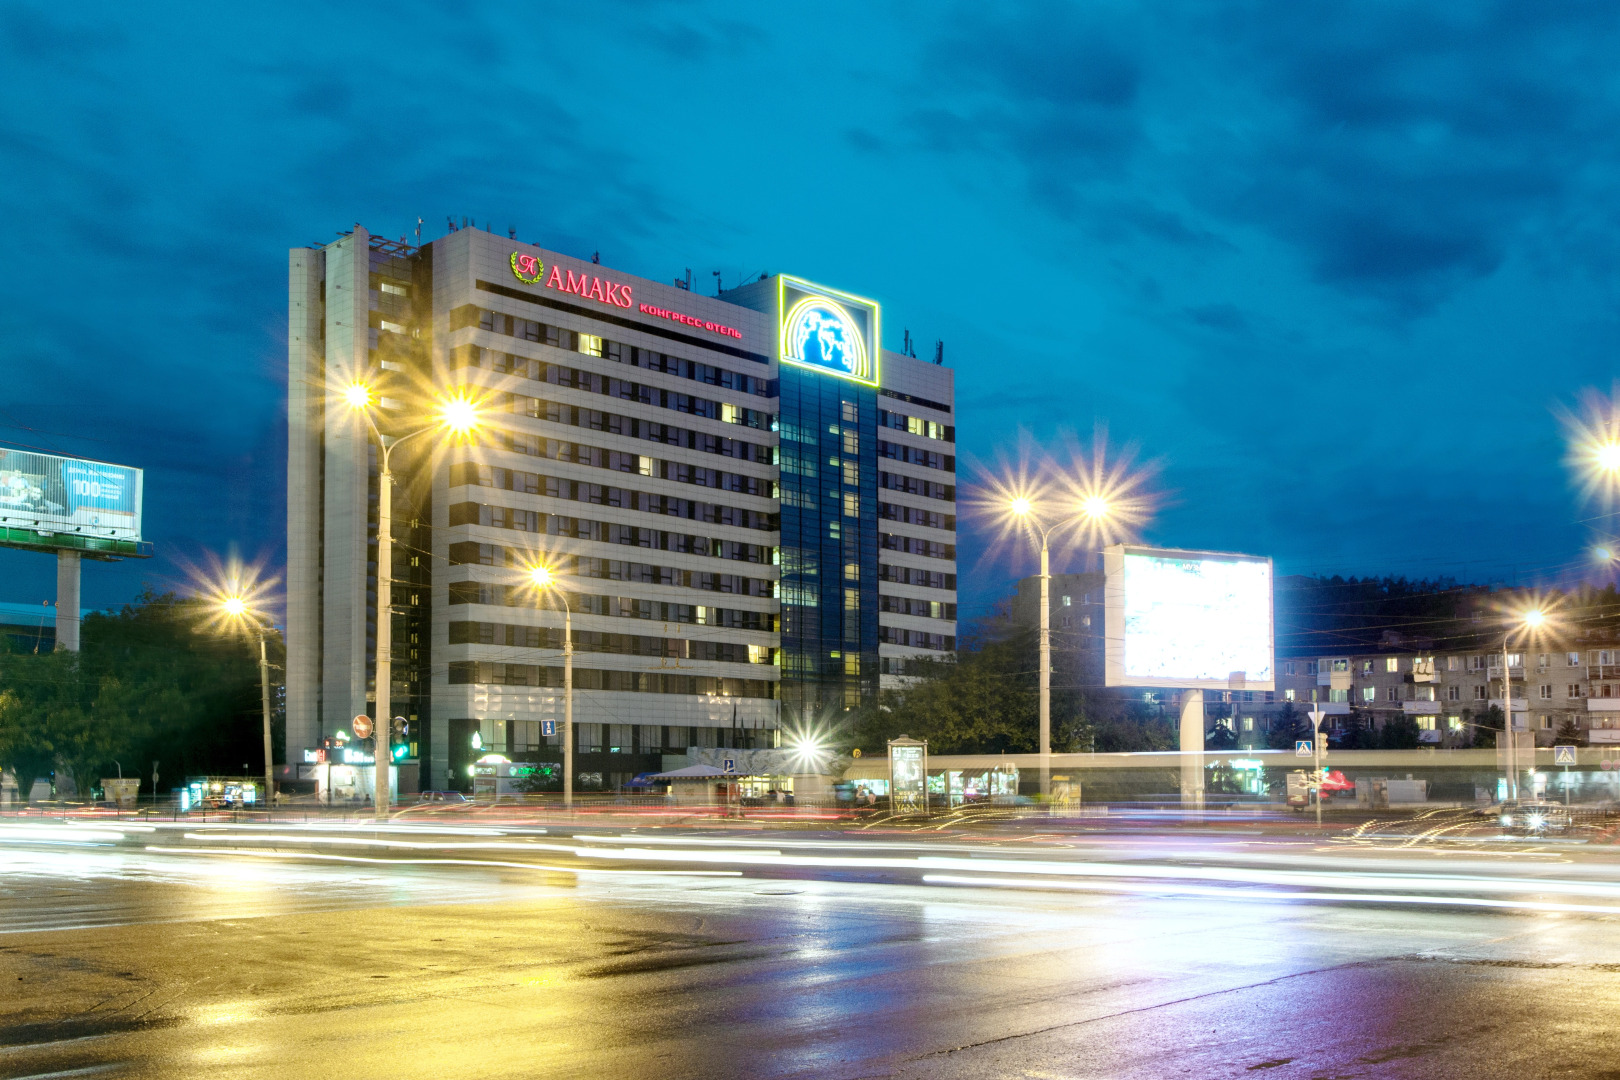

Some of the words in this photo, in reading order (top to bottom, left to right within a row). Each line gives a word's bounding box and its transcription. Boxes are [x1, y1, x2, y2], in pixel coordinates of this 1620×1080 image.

[545, 265, 633, 309] AMAKS
[639, 302, 743, 339] КОНГРЕСС-ОТЕЛЬ
[73, 479, 100, 498] 100
